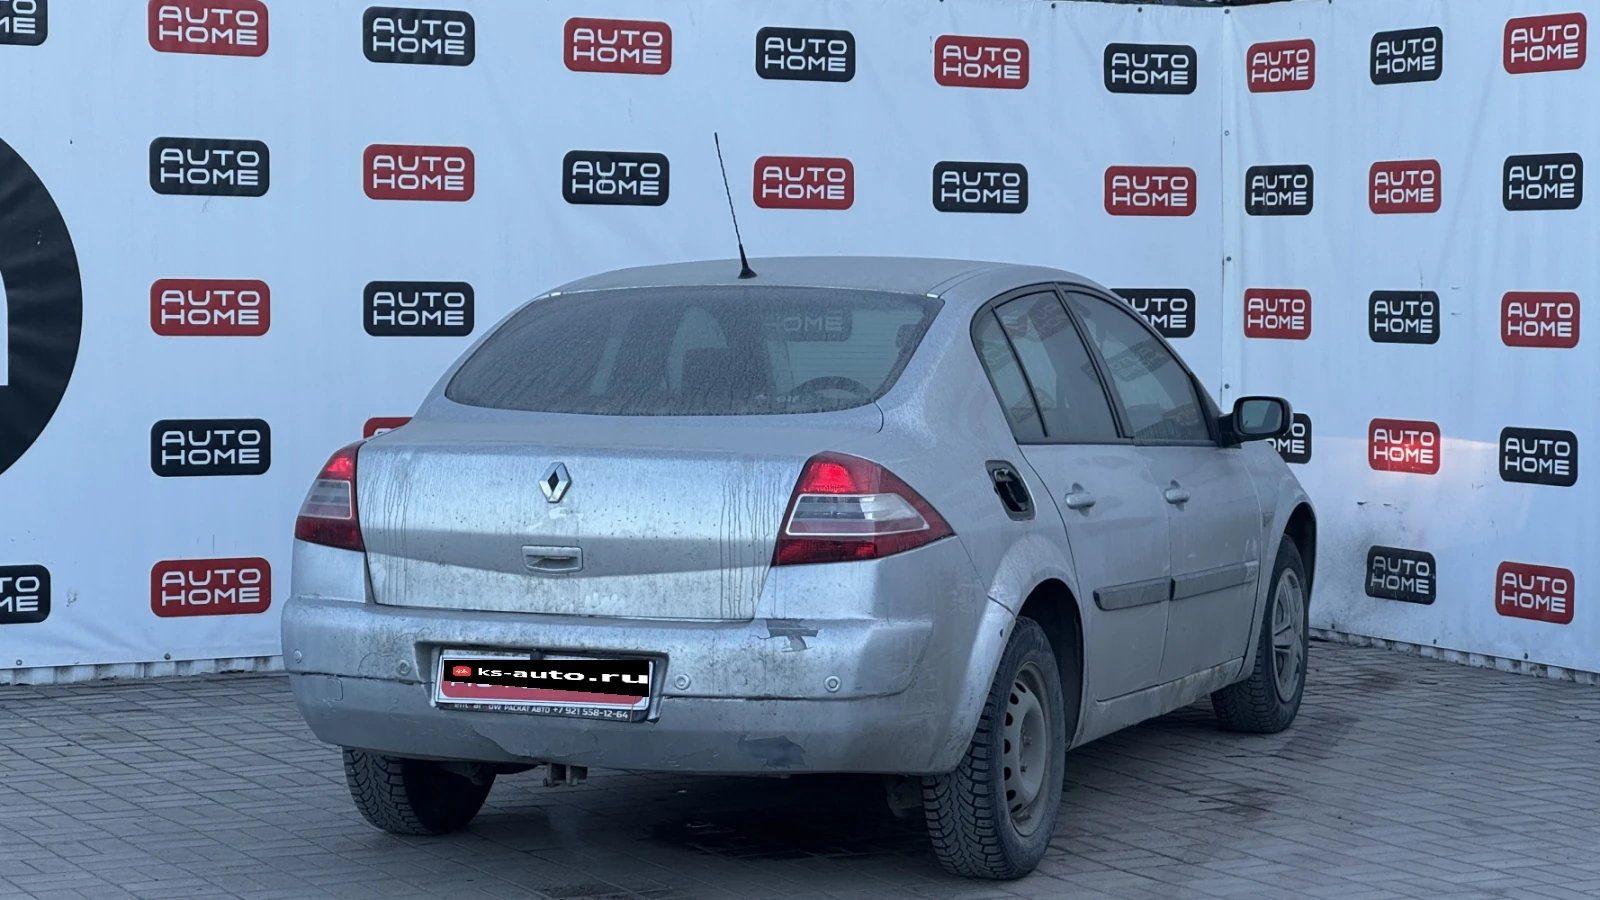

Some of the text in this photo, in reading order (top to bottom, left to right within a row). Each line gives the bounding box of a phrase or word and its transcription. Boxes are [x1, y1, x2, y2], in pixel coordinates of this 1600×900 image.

[159, 5, 258, 26] AUTO
[159, 24, 257, 45] HOME
[373, 17, 466, 37] AUTO
[1511, 24, 1580, 44] AUTO
[373, 36, 464, 55] HOME
[574, 28, 663, 46] AUTO
[765, 37, 847, 55] AUTO
[943, 45, 1021, 63] AUTO
[1376, 37, 1436, 57] AUTO
[1511, 42, 1578, 63] HOME
[573, 46, 662, 64] HOME
[765, 54, 846, 72] HOME
[1112, 53, 1189, 68] AUTO
[1252, 49, 1310, 66] AUTO
[943, 62, 1020, 79] HOME
[1376, 55, 1435, 74] HOME
[1112, 69, 1188, 85] HOME
[1251, 66, 1308, 83] HOME
[160, 148, 259, 167] AUTO
[373, 155, 465, 172] AUTO
[160, 167, 258, 186] HOME
[572, 161, 660, 178] AUTO
[763, 166, 846, 182] AUTO
[1375, 170, 1435, 186] AUTO
[1509, 164, 1576, 181] AUTO
[373, 173, 464, 191] HOME
[572, 179, 659, 195] HOME
[941, 171, 1020, 187] AUTO
[1112, 175, 1188, 190] AUTO
[1252, 174, 1308, 189] AUTO
[762, 183, 845, 200] HOME
[941, 188, 1019, 204] HOME
[1112, 192, 1187, 206] HOME
[1251, 191, 1307, 206] HOME
[1375, 188, 1434, 204] HOME
[1509, 182, 1575, 200] HOME
[161, 290, 260, 306] AUTO
[373, 292, 465, 307] AUTO
[1123, 298, 1188, 312] UTO
[1248, 298, 1305, 313] AUTO
[161, 309, 259, 325] HOME
[1374, 301, 1434, 316] AUTO
[1508, 302, 1573, 318] AUTO
[373, 310, 464, 325] HOME
[1141, 314, 1187, 328] ME
[1248, 314, 1304, 330] HOME
[1374, 318, 1433, 333] HOME
[1508, 320, 1572, 337] HOME
[162, 430, 261, 446] AUTO
[1265, 438, 1305, 454] ME
[1374, 429, 1434, 447] AUTO
[1374, 445, 1433, 464] HOME
[1505, 438, 1570, 457] AUTO
[162, 448, 259, 465] HOME
[1505, 455, 1569, 475] HOME
[1373, 556, 1430, 576] AUTO
[0, 576, 40, 593] TO
[162, 568, 261, 587] AUTO
[1370, 573, 1429, 594] HOME
[1502, 572, 1567, 594] AUTO
[0, 595, 38, 612] ME
[162, 587, 260, 606] HOME
[1501, 590, 1566, 613] HOME
[565, 707, 580, 715] 921
[581, 708, 629, 719] 558-12-64
